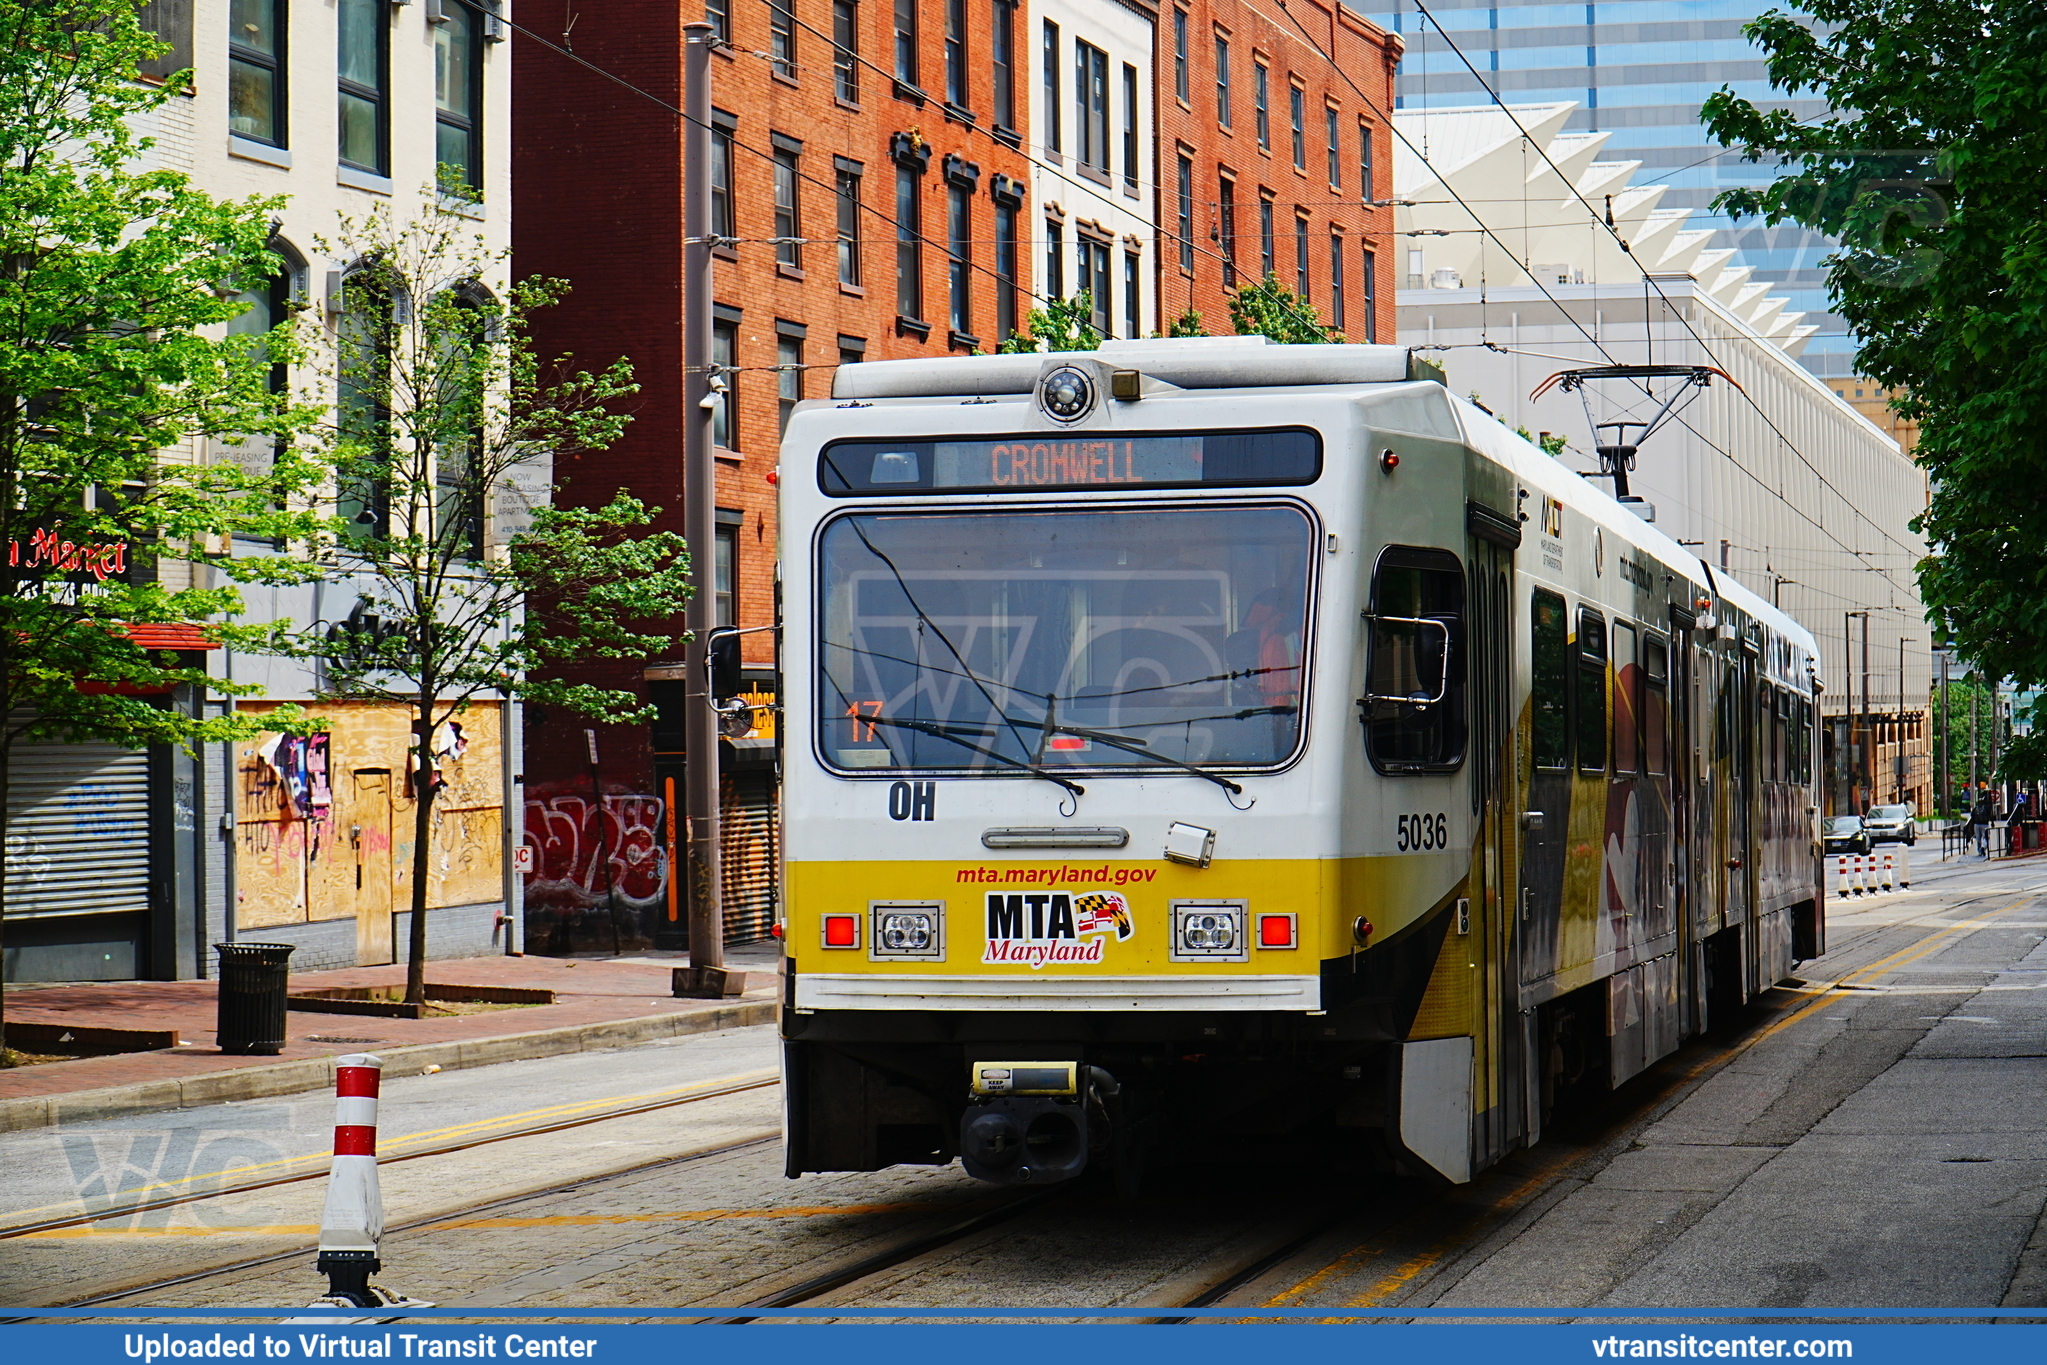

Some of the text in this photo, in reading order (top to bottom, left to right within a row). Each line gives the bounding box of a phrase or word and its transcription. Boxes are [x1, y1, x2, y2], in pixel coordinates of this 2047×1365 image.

[214, 452, 268, 463] PRE-LEASING
[509, 473, 532, 481] NOW
[992, 441, 1143, 486] CROMWELL
[845, 701, 884, 742] 17
[889, 781, 936, 821] OH
[1397, 812, 1447, 852] 5036
[956, 865, 1157, 886] mta.maryland.gov
[988, 894, 1076, 939] MTA
[985, 939, 1102, 966] Maryland
